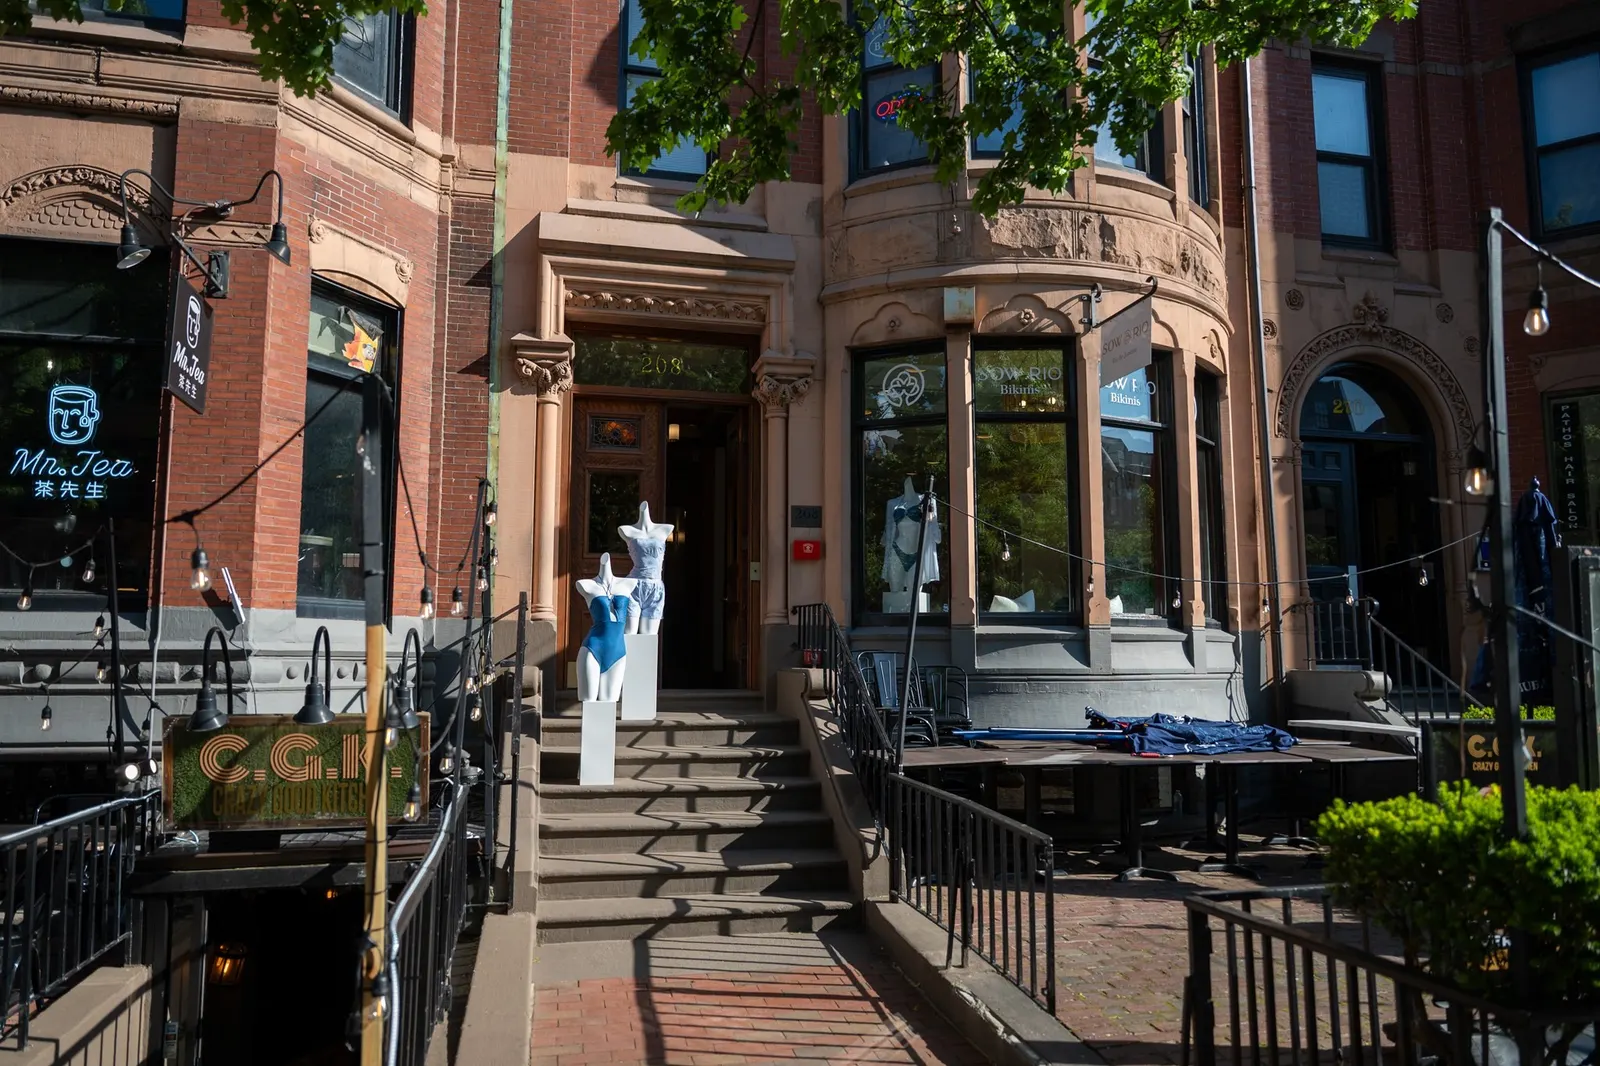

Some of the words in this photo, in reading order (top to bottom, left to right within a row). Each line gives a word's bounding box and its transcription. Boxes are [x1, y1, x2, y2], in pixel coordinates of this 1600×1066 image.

[1102, 334, 1123, 355] SOW
[1133, 321, 1149, 338] RIO
[642, 355, 681, 375] 208
[979, 366, 1023, 381] SOW
[1029, 366, 1062, 381] RIO
[178, 373, 197, 399] 茶先生
[1000, 384, 1041, 395] Bikinis
[1110, 392, 1141, 406] Bikinis
[1561, 405, 1572, 448] PATHOS
[1564, 456, 1575, 485] HAIR
[35, 480, 104, 498] 茶先生
[1567, 493, 1578, 529] SALON
[1472, 761, 1493, 771] CRAZY
[213, 784, 267, 816] CRAZY
[272, 784, 317, 815] GOOD
[321, 781, 391, 814] KITCH
